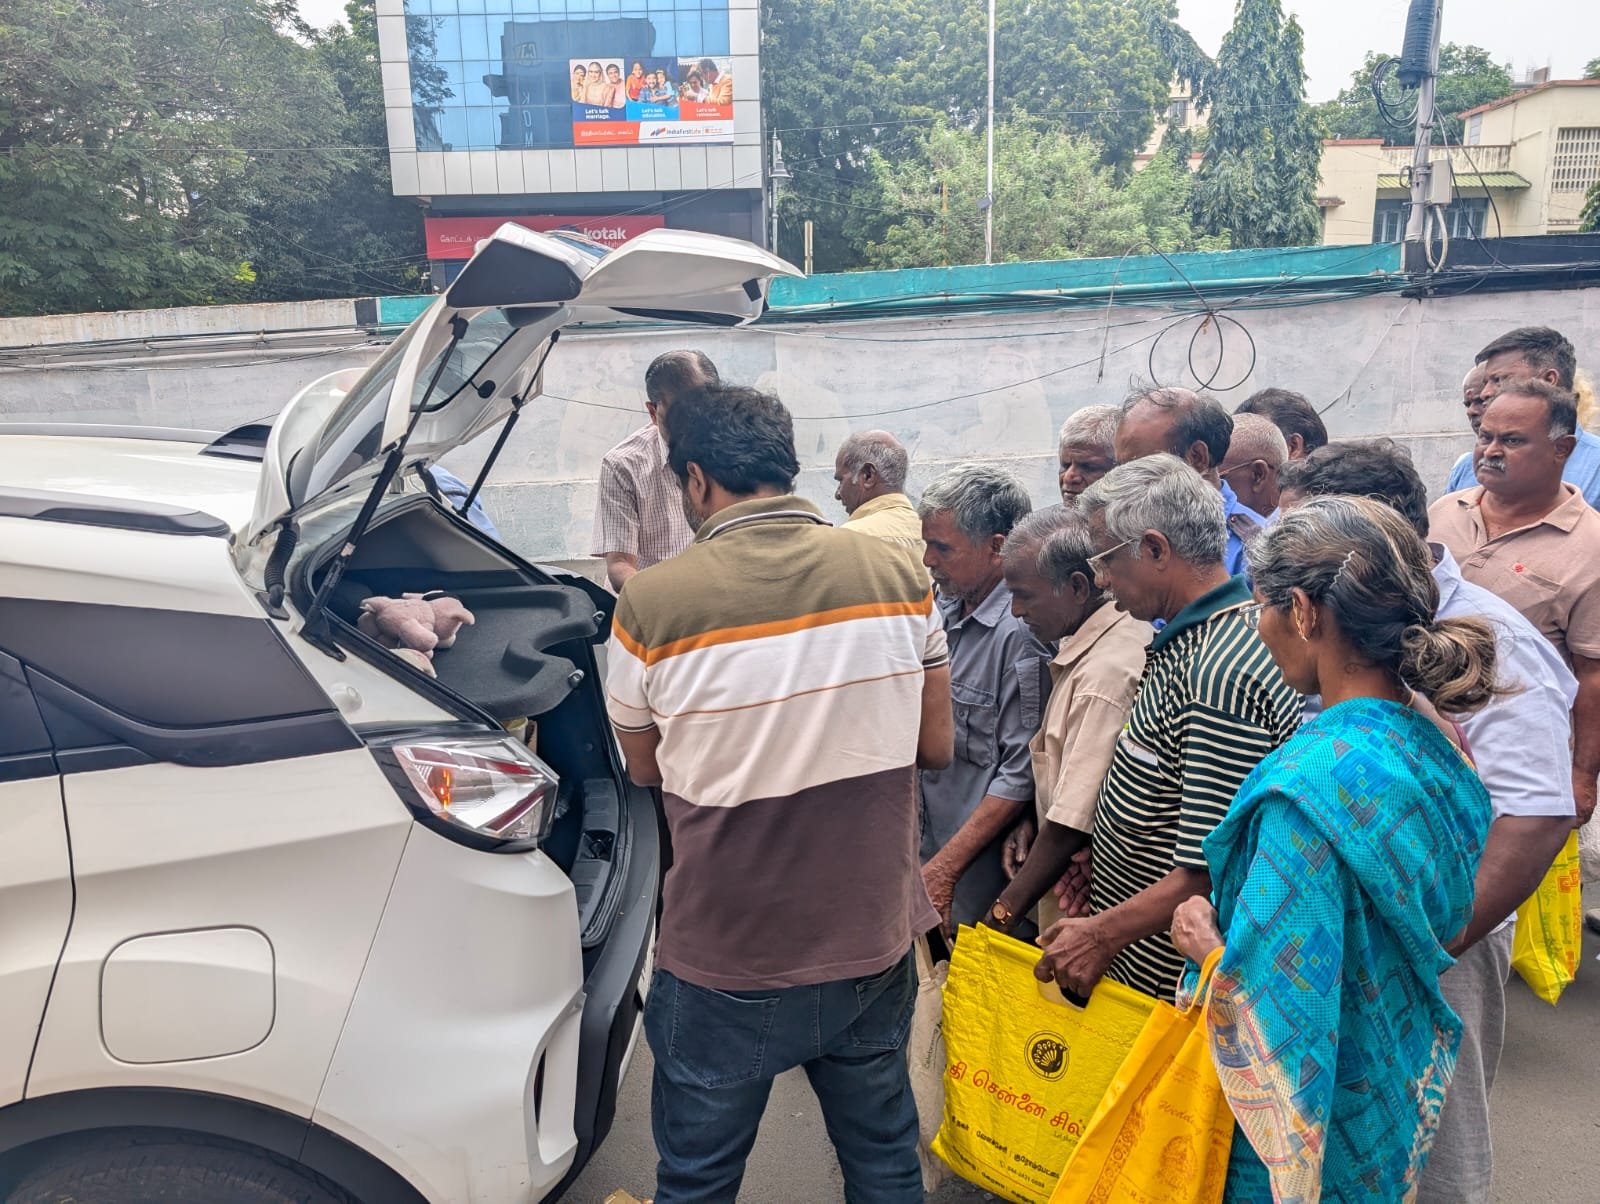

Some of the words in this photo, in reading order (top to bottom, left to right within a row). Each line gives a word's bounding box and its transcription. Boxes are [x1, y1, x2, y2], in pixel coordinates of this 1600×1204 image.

[583, 227, 627, 240] kotak
[949, 1061, 968, 1080] தி
[973, 1069, 1047, 1119] சென்னை
